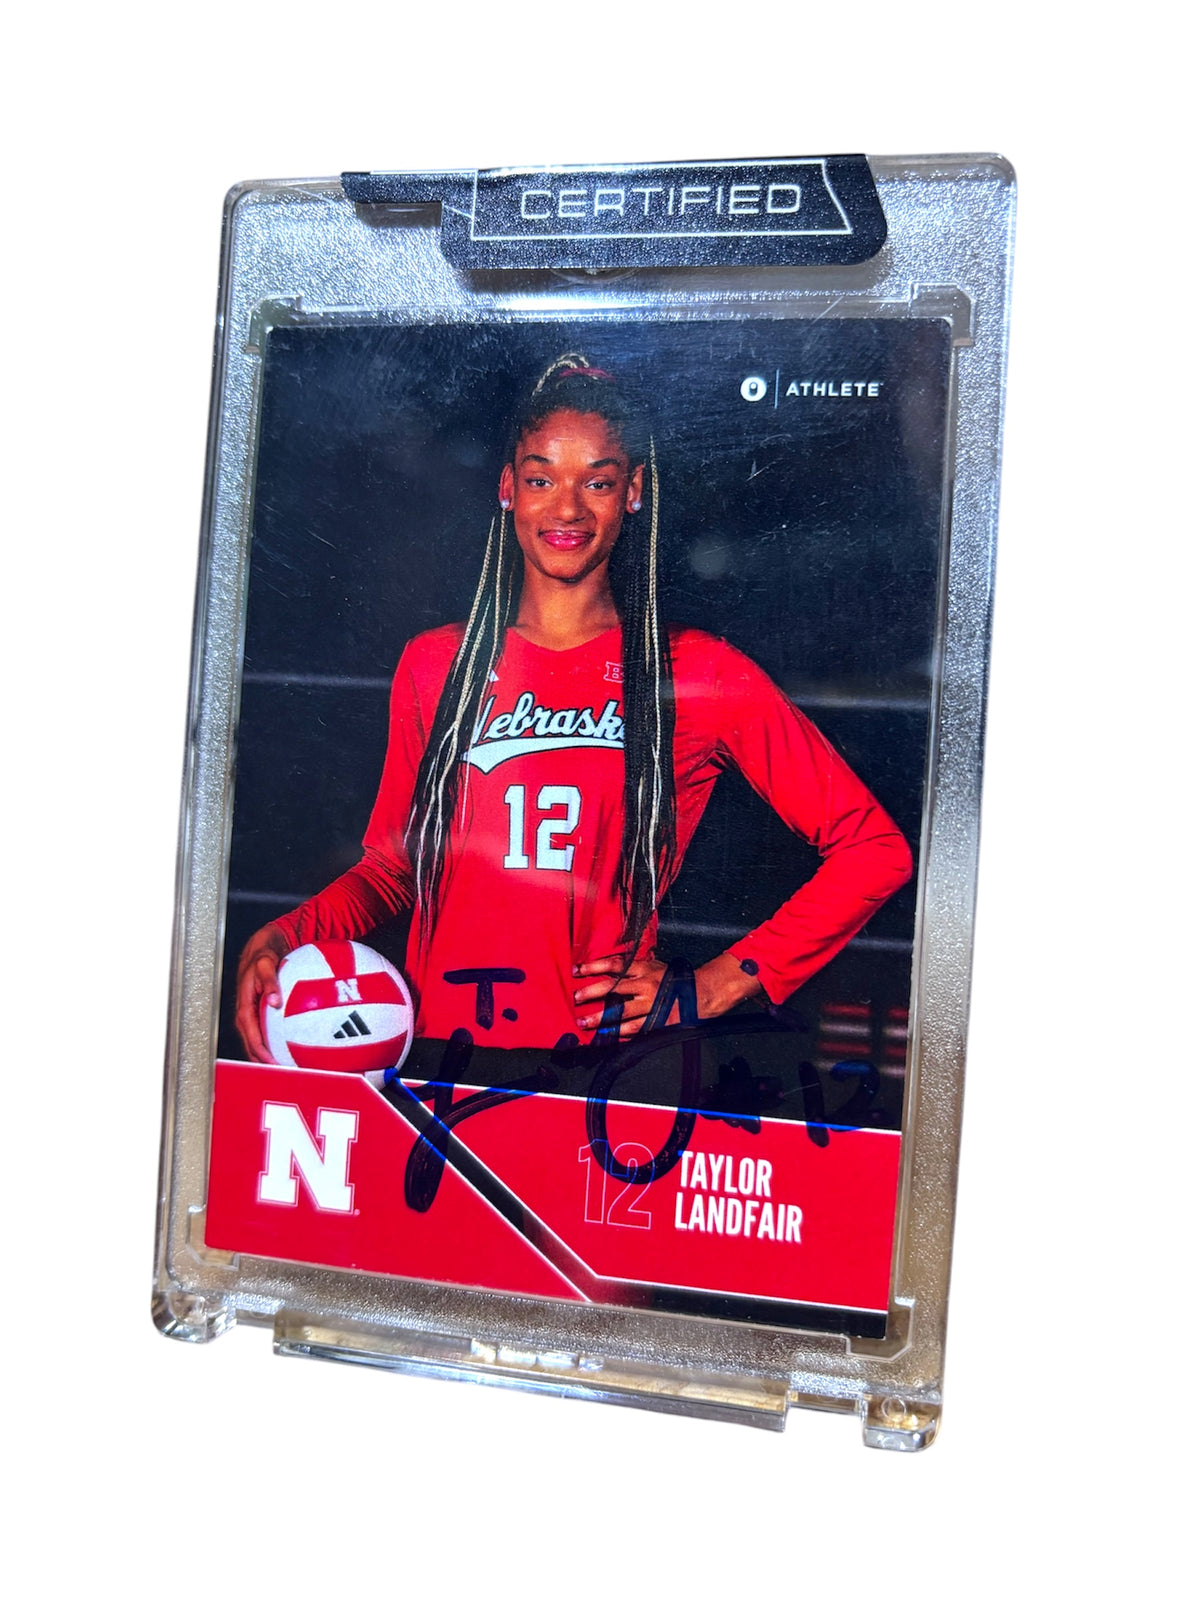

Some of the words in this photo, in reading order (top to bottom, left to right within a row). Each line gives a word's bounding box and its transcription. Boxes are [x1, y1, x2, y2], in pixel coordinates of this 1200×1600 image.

[520, 184, 801, 219] CERTIFIED
[785, 382, 880, 397] ATHLETE
[472, 691, 626, 742] ebrask
[503, 784, 582, 872] 12
[334, 978, 363, 1003] N
[256, 1100, 360, 1216] N
[578, 1137, 656, 1230] 12
[679, 1150, 773, 1197] TAYLOR
[674, 1191, 803, 1243] LANDFAIR
